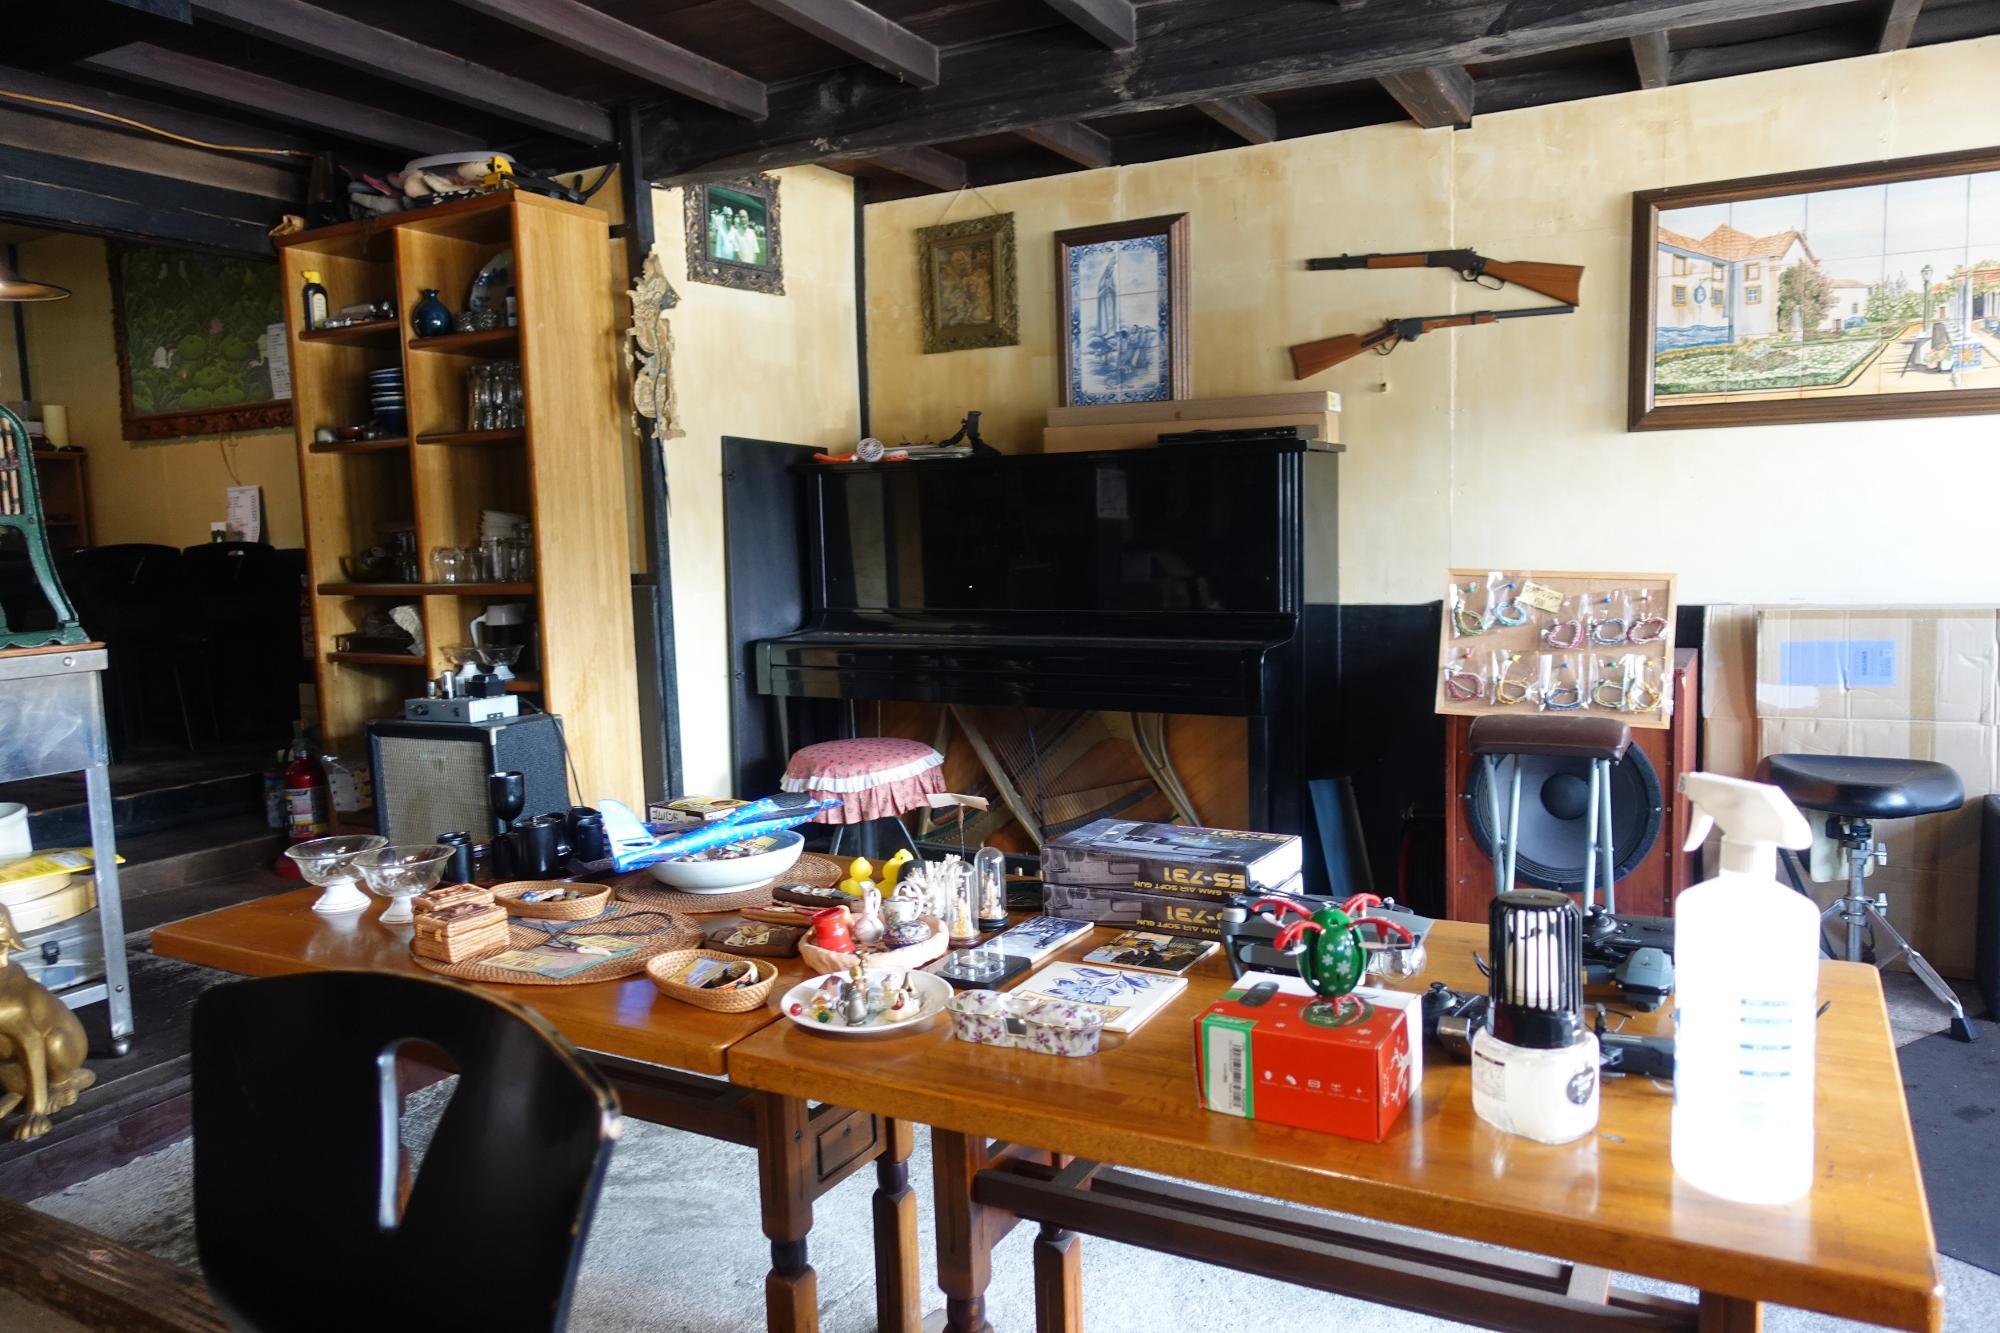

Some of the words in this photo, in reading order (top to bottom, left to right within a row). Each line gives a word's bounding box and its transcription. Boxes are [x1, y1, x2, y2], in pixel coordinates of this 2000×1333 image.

[1163, 867, 1246, 889] ES-731
[1154, 883, 1178, 891] SOFT
[1166, 905, 1223, 925] -731
[1136, 919, 1156, 927] GUN
[1156, 921, 1181, 929] SOFT
